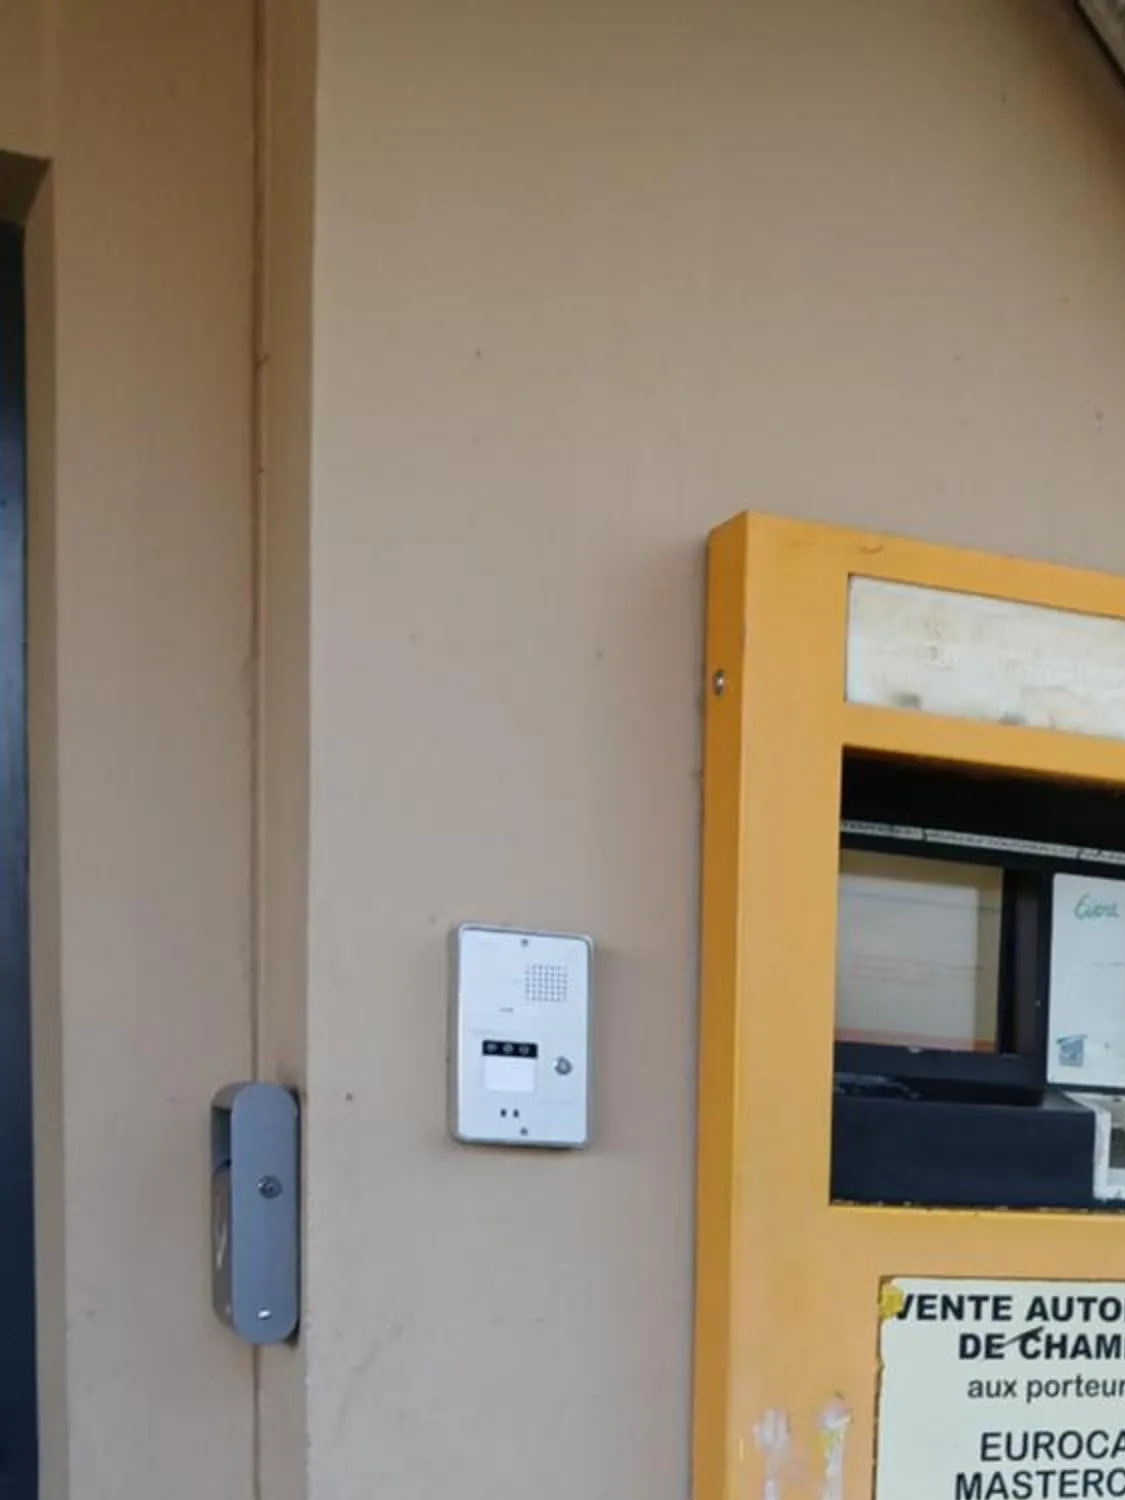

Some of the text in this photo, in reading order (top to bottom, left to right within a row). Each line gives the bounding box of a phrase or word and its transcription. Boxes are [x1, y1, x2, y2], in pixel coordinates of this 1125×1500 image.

[895, 1293, 1013, 1321] VENTE
[958, 1332, 1005, 1360] DE
[967, 1379, 1017, 1398] aux
